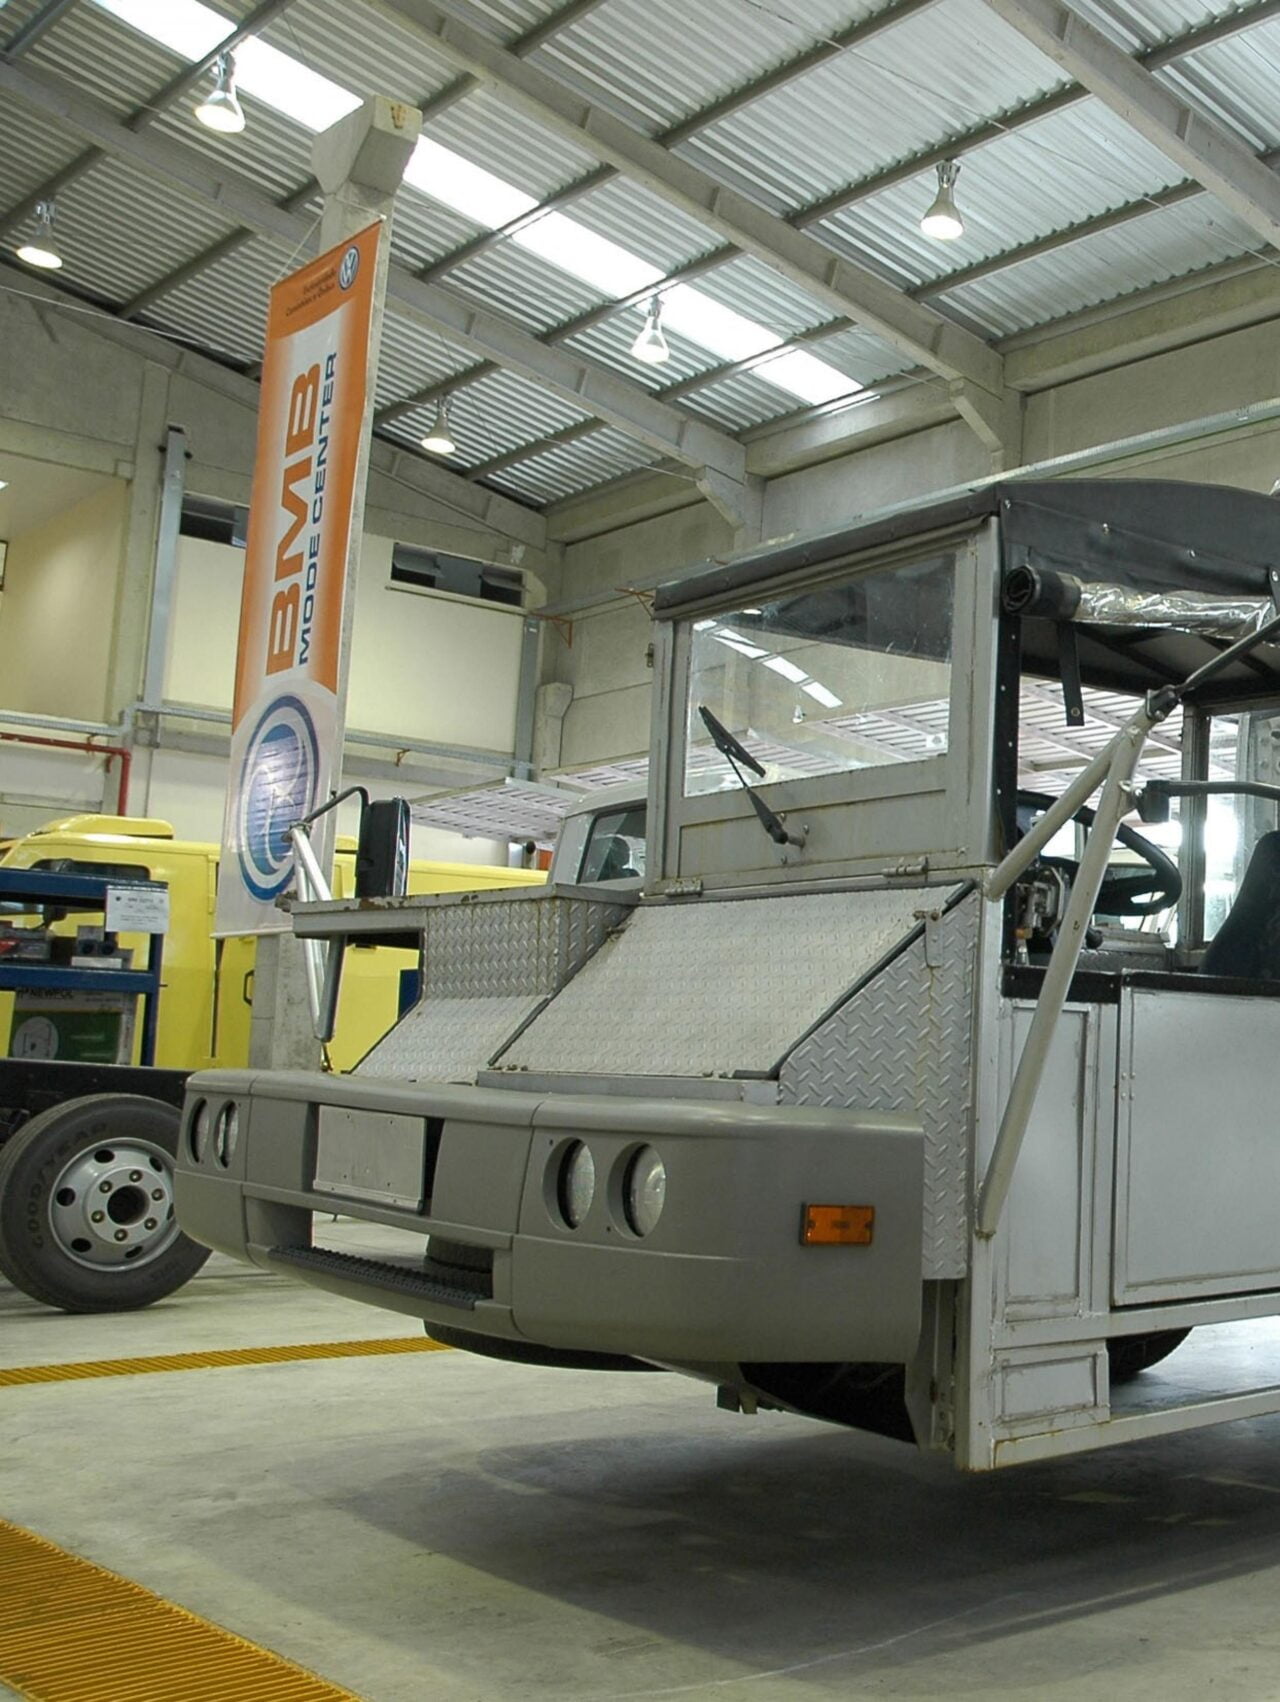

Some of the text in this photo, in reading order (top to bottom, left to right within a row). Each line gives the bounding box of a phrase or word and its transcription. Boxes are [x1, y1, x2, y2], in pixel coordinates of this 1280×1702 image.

[266, 363, 320, 676] BMB
[299, 352, 337, 665] MODE CENTER
